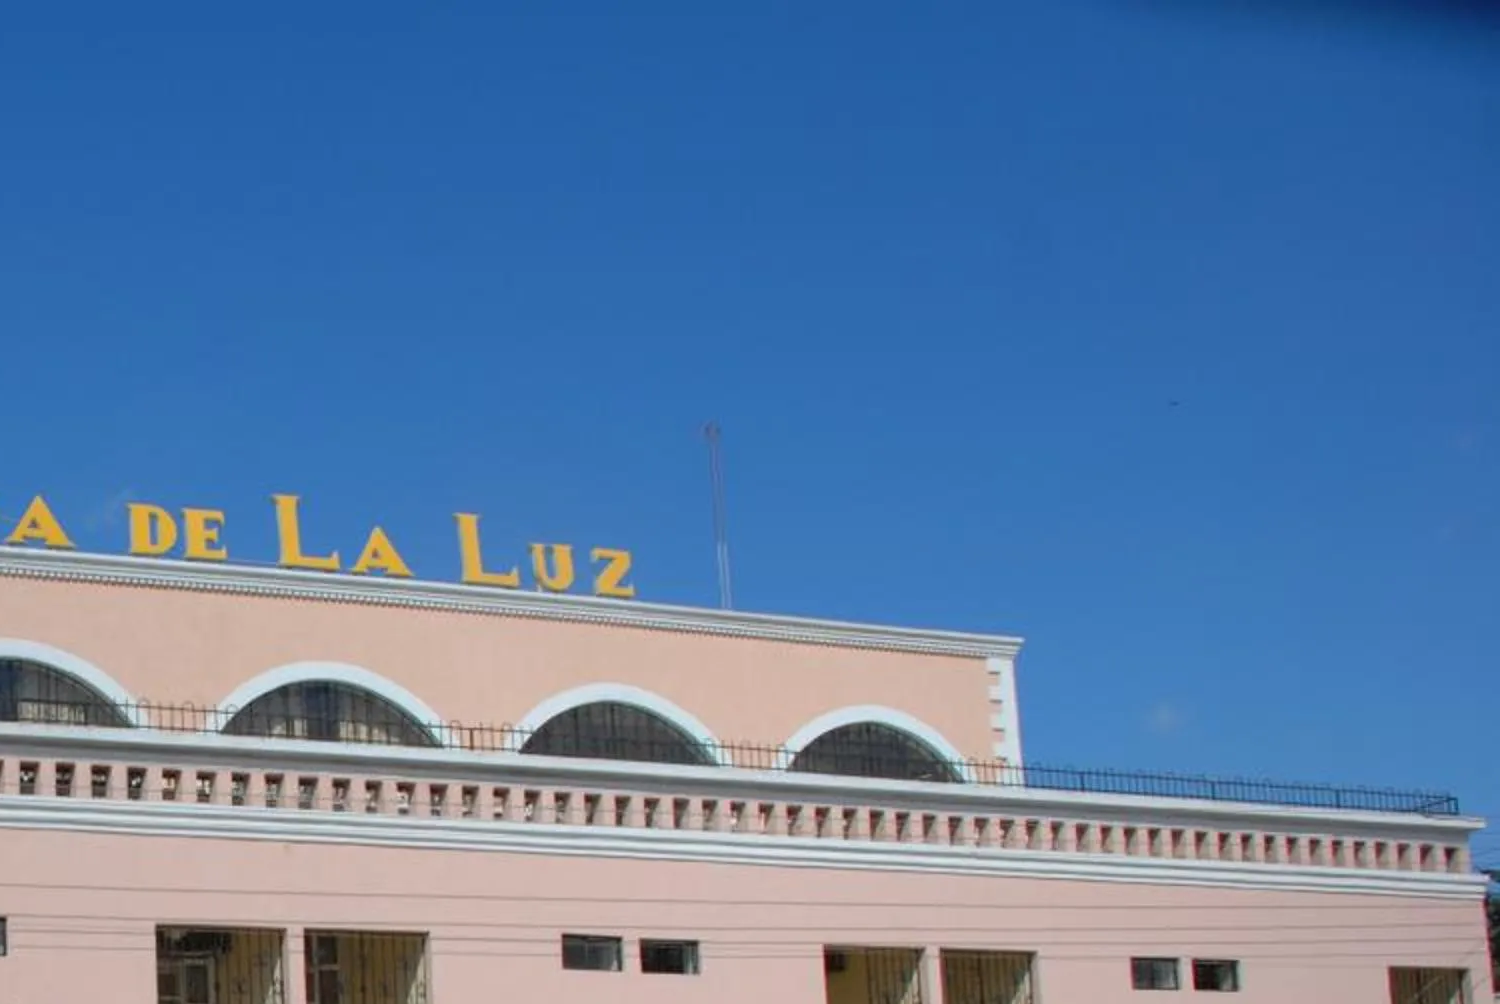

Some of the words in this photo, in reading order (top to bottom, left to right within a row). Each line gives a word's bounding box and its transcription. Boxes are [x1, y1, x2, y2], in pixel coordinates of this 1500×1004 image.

[132, 505, 226, 560] DE
[277, 496, 409, 576] LA
[459, 515, 632, 596] LUZ
